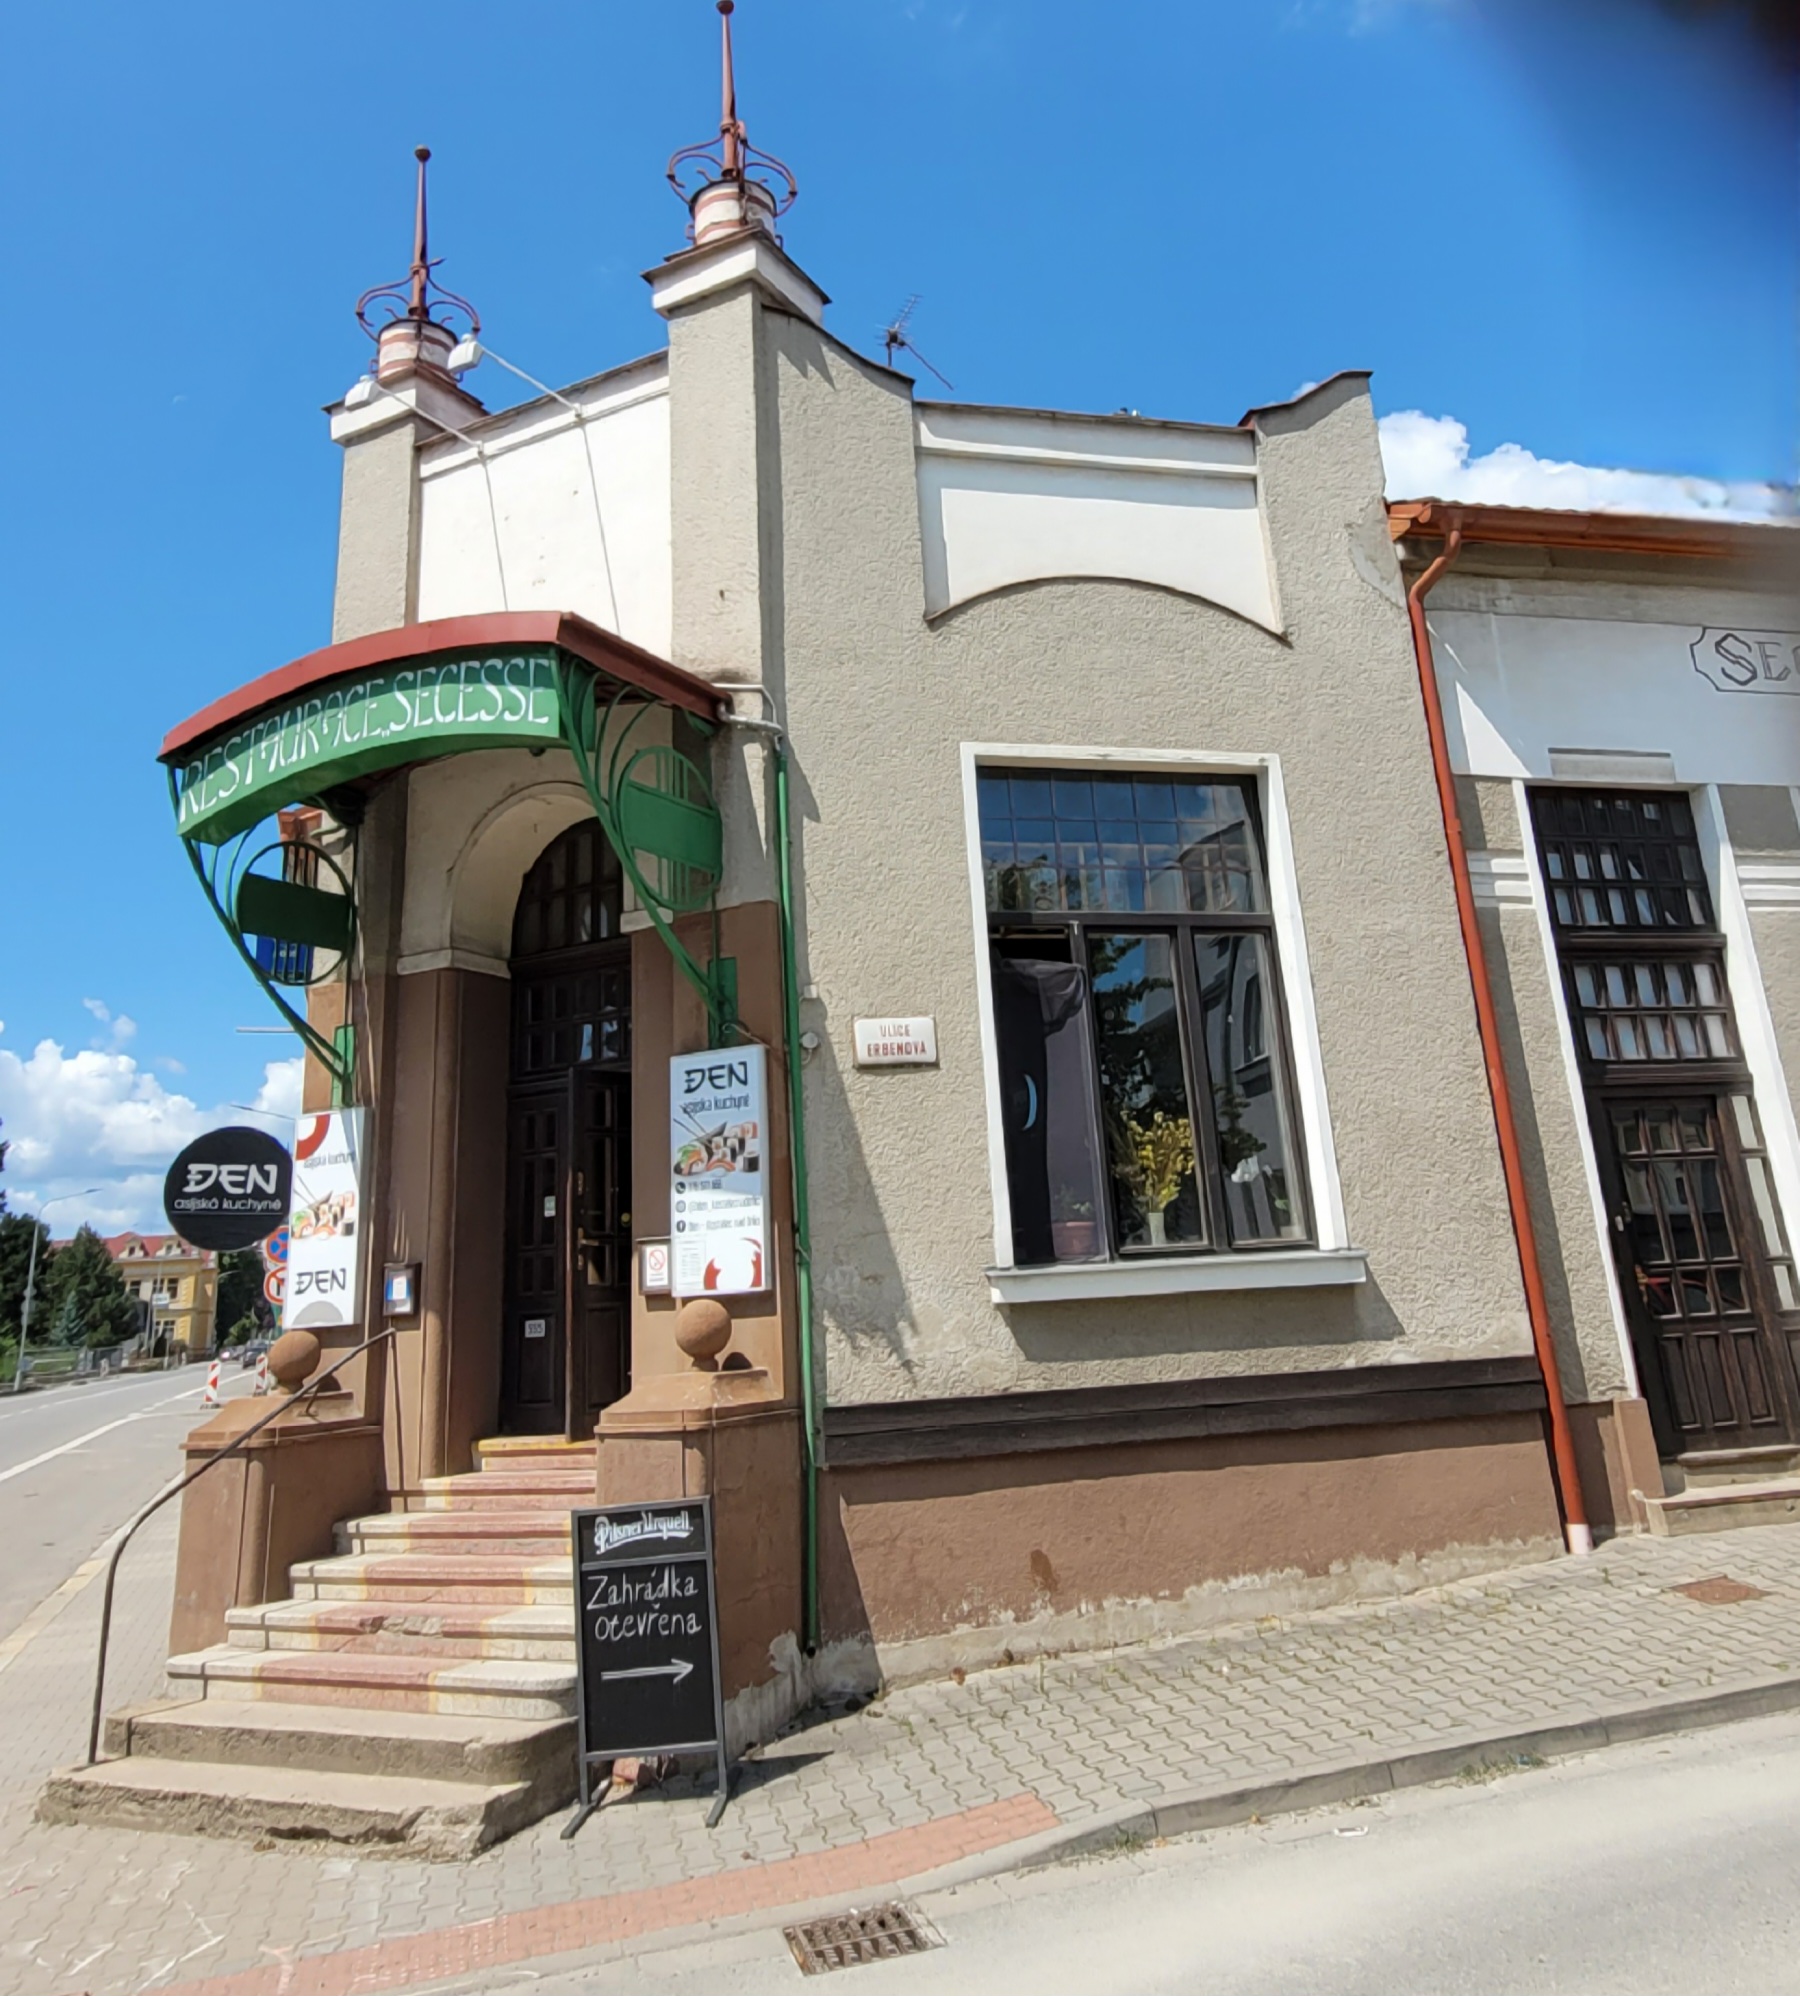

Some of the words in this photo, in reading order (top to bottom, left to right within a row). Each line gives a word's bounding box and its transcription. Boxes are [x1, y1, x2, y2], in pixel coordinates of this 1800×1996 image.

[1714, 632, 1800, 686] SE
[180, 678, 385, 824] RESTAURACE
[867, 1041, 926, 1057] ERBENOVA
[880, 1024, 911, 1037] ULICE
[594, 1516, 641, 1555] Pilsner
[586, 1564, 699, 1611] Zahrádka
[594, 1602, 702, 1641] otevřena
